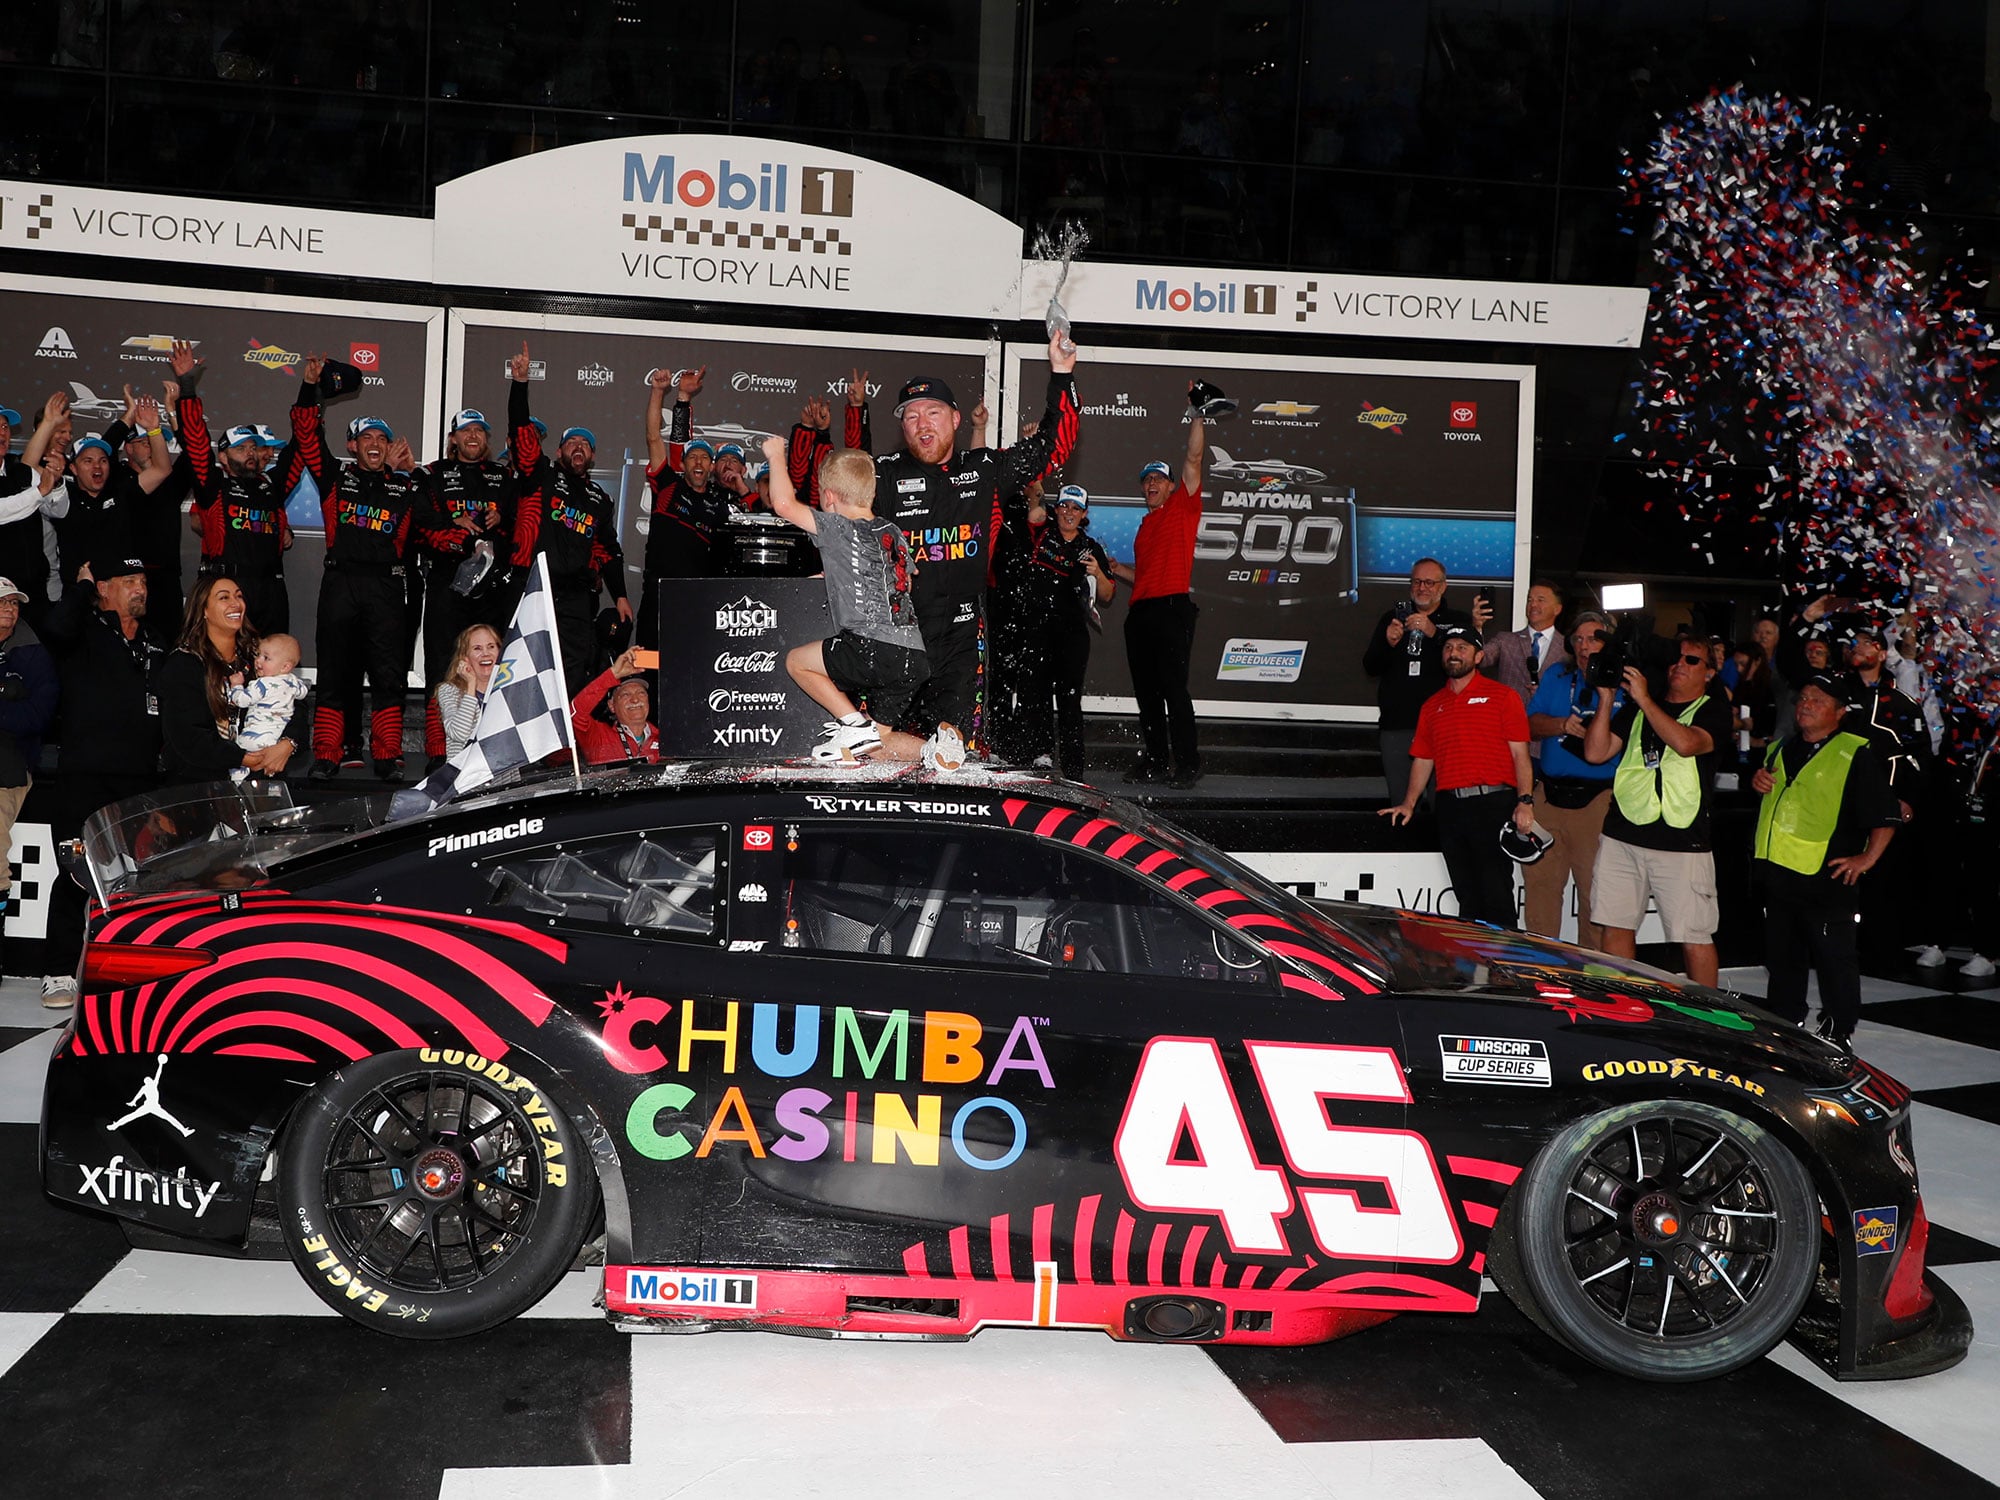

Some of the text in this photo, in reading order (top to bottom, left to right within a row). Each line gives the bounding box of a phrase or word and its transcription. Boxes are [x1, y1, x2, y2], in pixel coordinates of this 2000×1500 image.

[623, 151, 787, 212] Mobil
[72, 206, 324, 253] VICTORY LANE
[621, 252, 851, 291] VICTORY LANE
[1136, 279, 1236, 313] Mobil
[1333, 291, 1549, 324] VICTORY LANE
[34, 349, 78, 359] AXALTA
[247, 351, 299, 364] SUNOCO
[577, 369, 614, 382] BUSCH
[750, 374, 797, 389] Freeway
[750, 386, 797, 394] INSURANCE
[826, 377, 883, 398] xfity
[1252, 419, 1320, 428] CHEVROLET
[1361, 412, 1406, 424] SUNOCO
[1444, 432, 1482, 442] TOYOTA
[1221, 491, 1313, 510] DAYTONA
[228, 504, 276, 523] CHUMB
[338, 501, 398, 523] CHUMBA
[340, 513, 393, 534] CASINO
[551, 509, 594, 539] CASINO
[1194, 511, 1344, 565] 500
[907, 540, 979, 563] ASINO
[1227, 570, 1301, 583] 20 26
[716, 610, 777, 630] BUSCH
[728, 627, 764, 637] LIGHT
[714, 651, 779, 673] Coca-Cola
[1228, 655, 1296, 666] SPEEDWEEKS
[731, 690, 786, 705] Freeway
[713, 723, 783, 747] xfinity
[837, 799, 901, 812] TYLER
[903, 801, 991, 816] REDDICK
[428, 818, 544, 857] Pinnacle
[594, 980, 1056, 1089] CHUMBA
[1475, 1040, 1531, 1055] NASCAR
[1458, 1058, 1535, 1075] CUP SERIES
[1582, 1058, 1766, 1097] GOODYEAR
[419, 1048, 569, 1188] GOODYEAR
[625, 1082, 1028, 1171] CASINO
[1113, 1035, 1464, 1265] 45
[78, 1155, 221, 1218] xfinity
[1857, 1227, 1894, 1240] SUNOCO
[302, 1233, 390, 1313] EAGLE
[631, 1275, 717, 1302] Mobil
